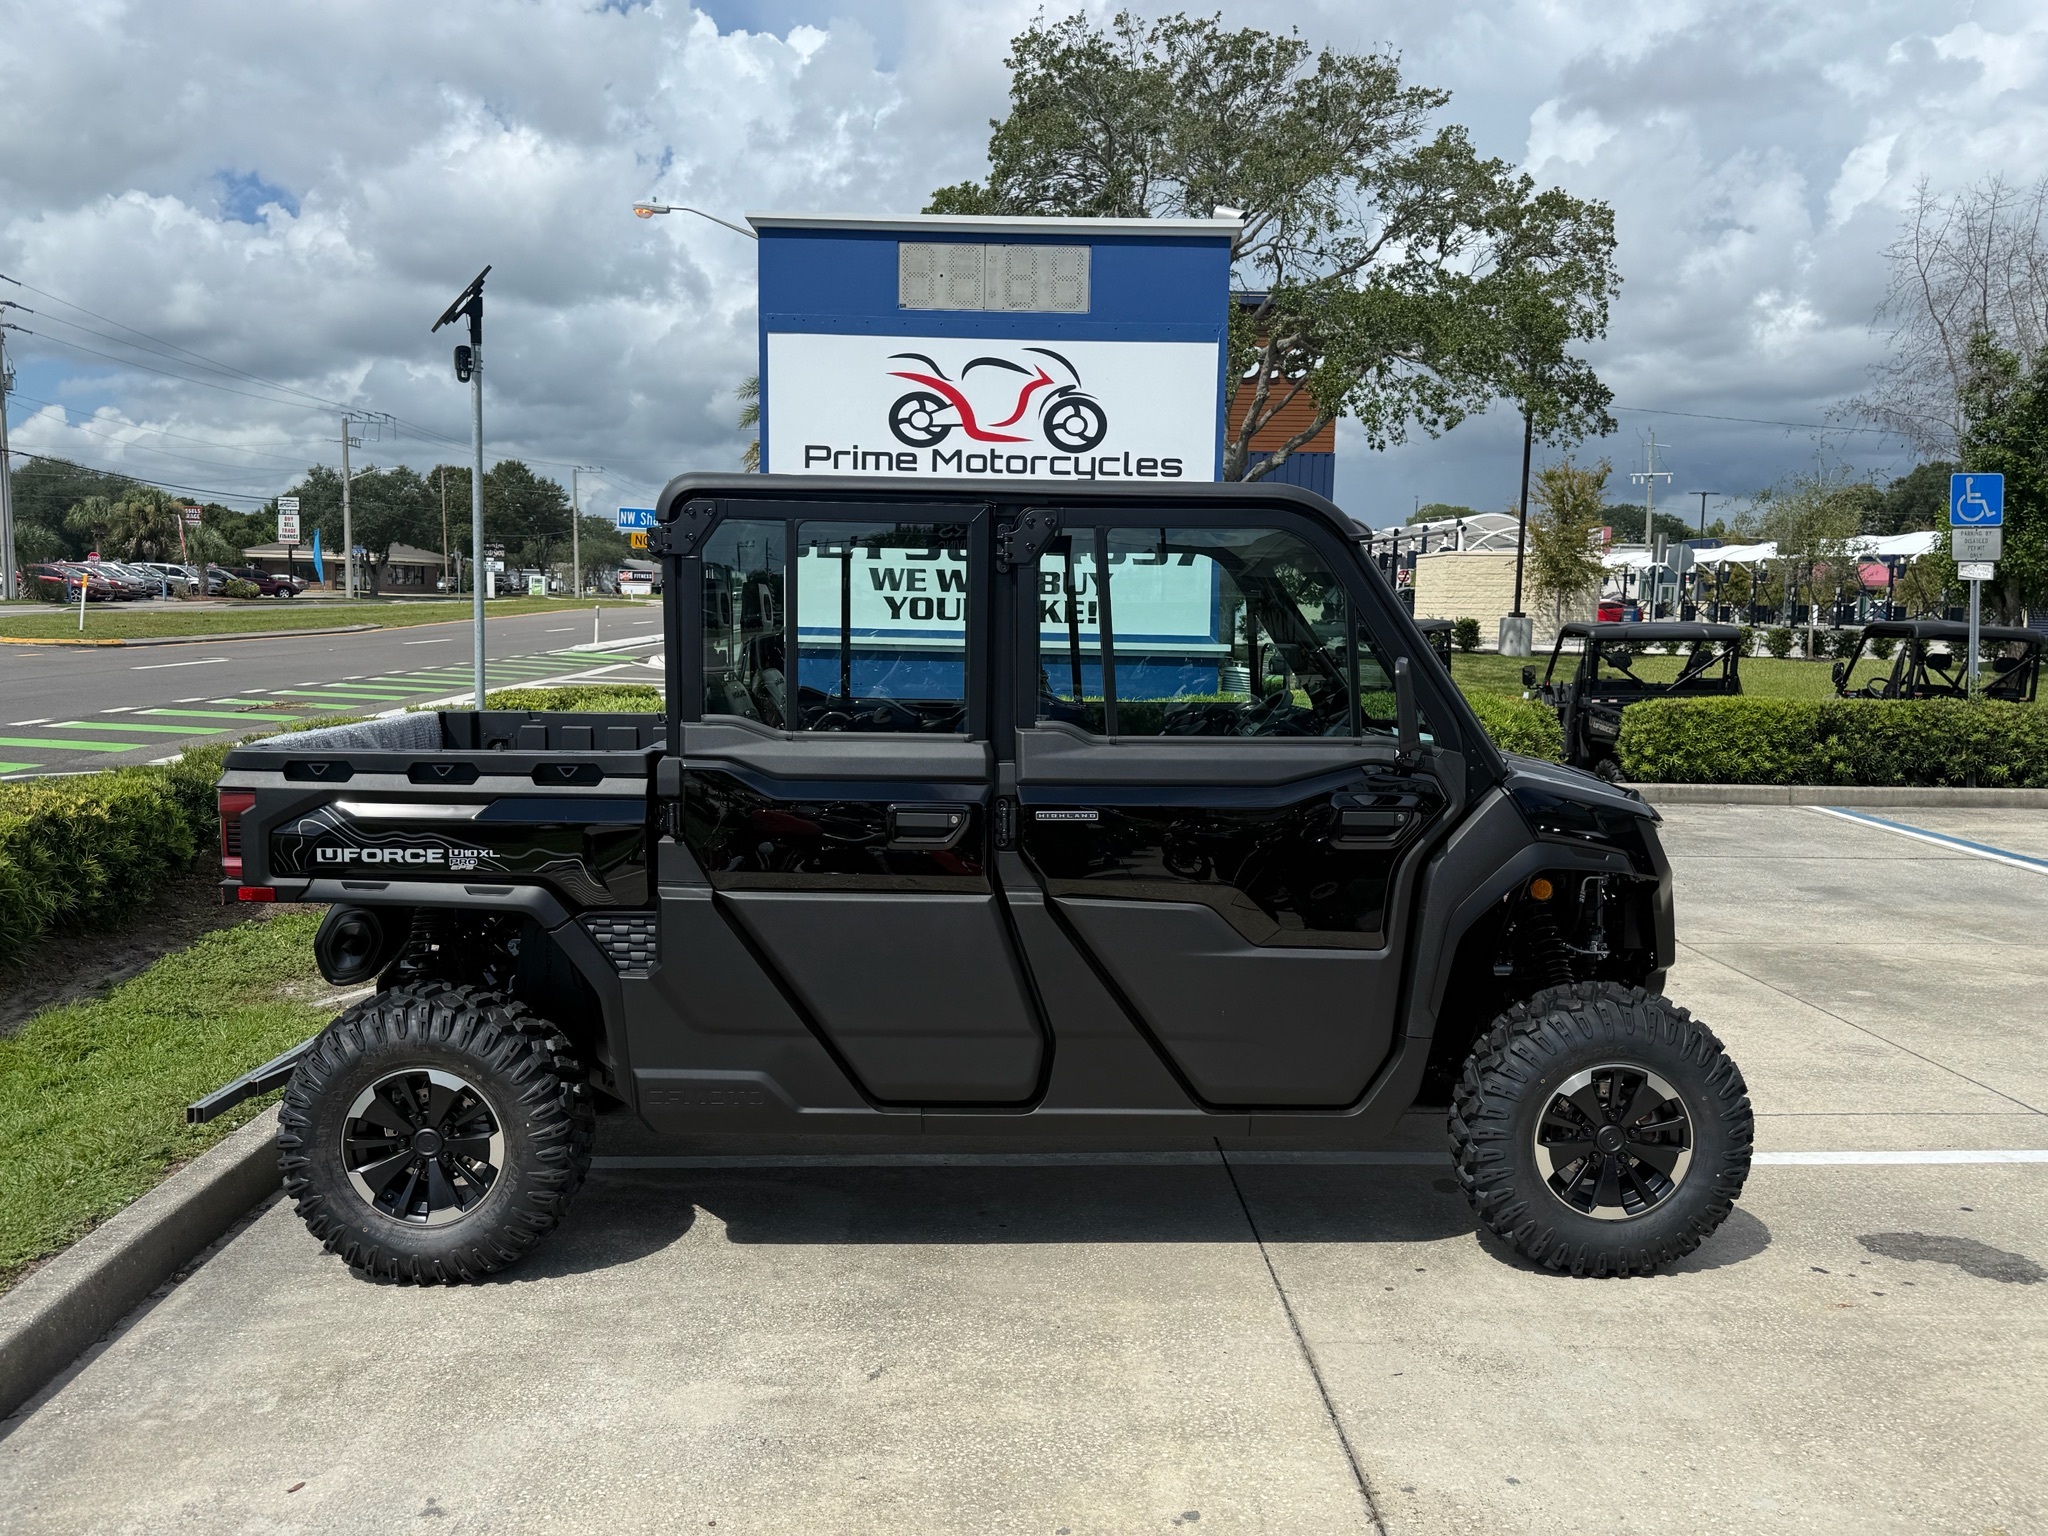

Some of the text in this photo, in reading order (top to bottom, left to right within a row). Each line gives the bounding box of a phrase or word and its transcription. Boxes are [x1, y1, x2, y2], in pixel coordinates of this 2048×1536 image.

[804, 444, 1183, 480] Prime Motorcycles
[620, 511, 636, 525] NW
[868, 567, 926, 592] WE
[883, 595, 966, 621] YOU
[316, 847, 445, 863] UFORCE
[449, 858, 478, 866] PRO
